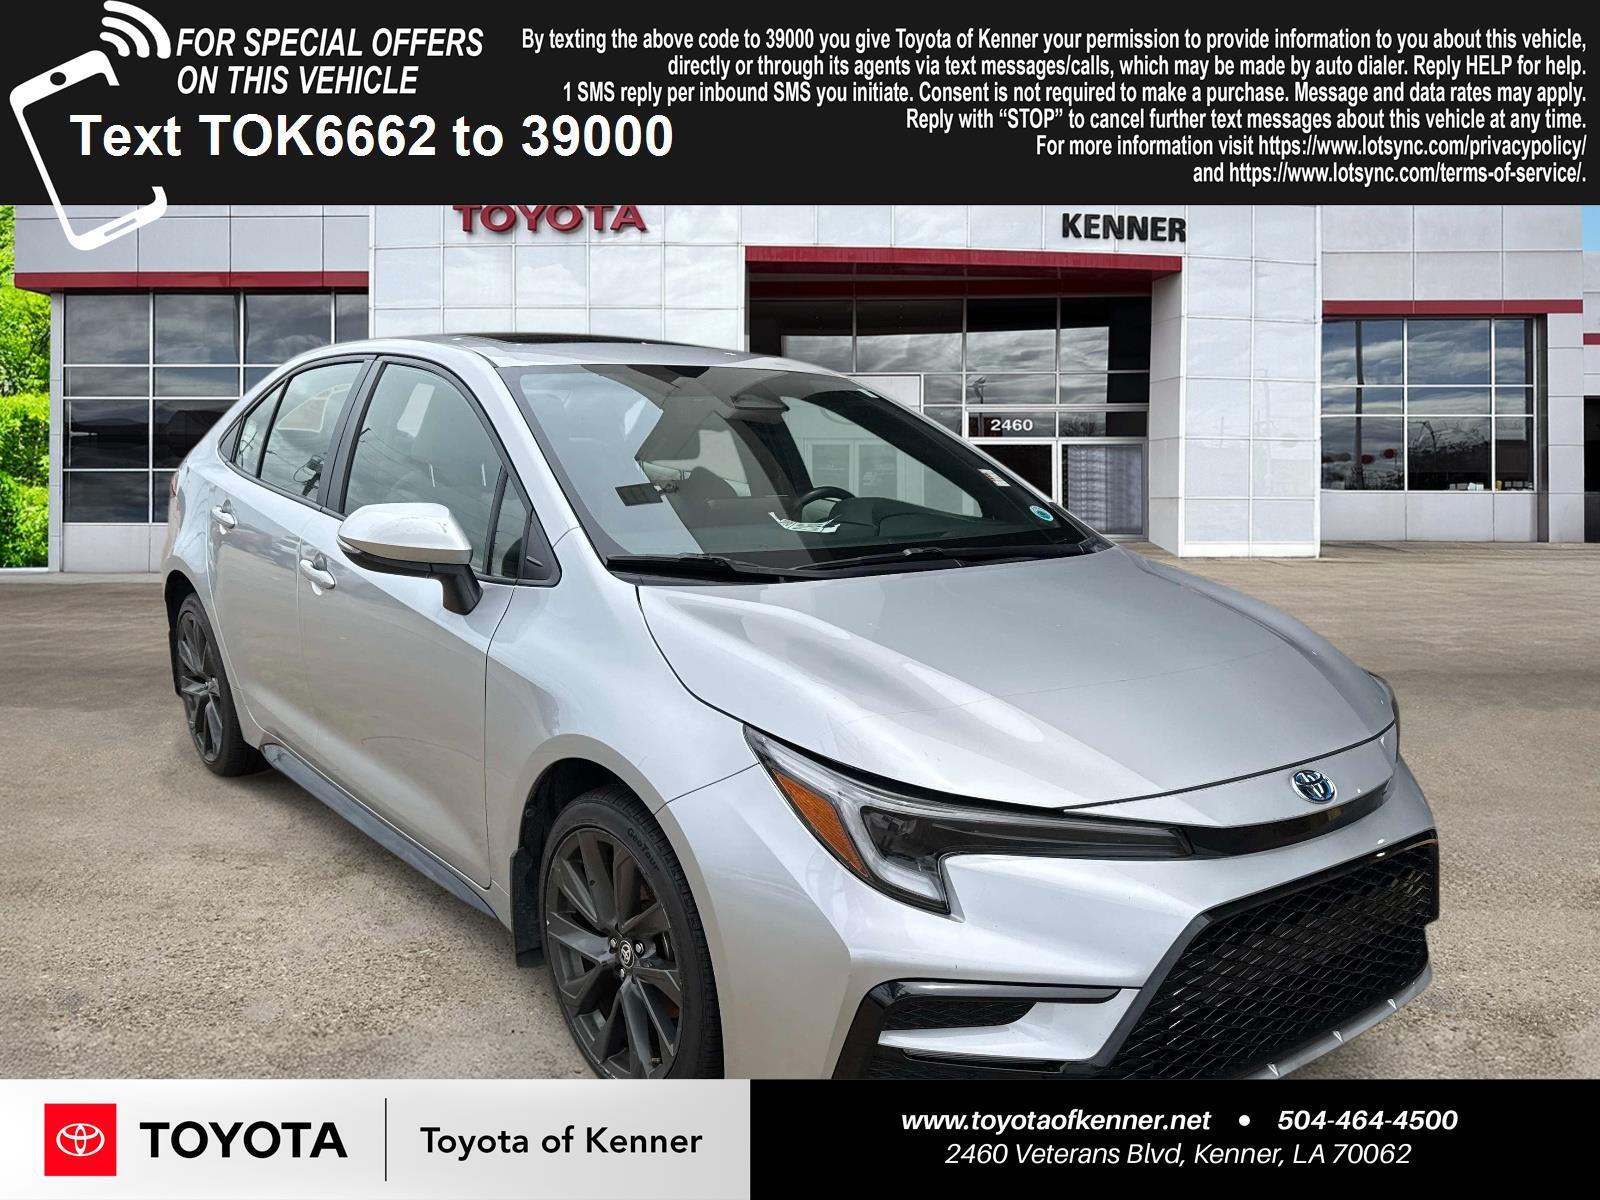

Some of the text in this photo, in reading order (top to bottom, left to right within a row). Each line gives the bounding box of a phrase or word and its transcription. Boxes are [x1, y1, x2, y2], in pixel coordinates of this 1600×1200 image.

[453, 205, 648, 233] TOYOTA
[1062, 213, 1187, 242] KENNER
[990, 418, 1034, 432] 2460
